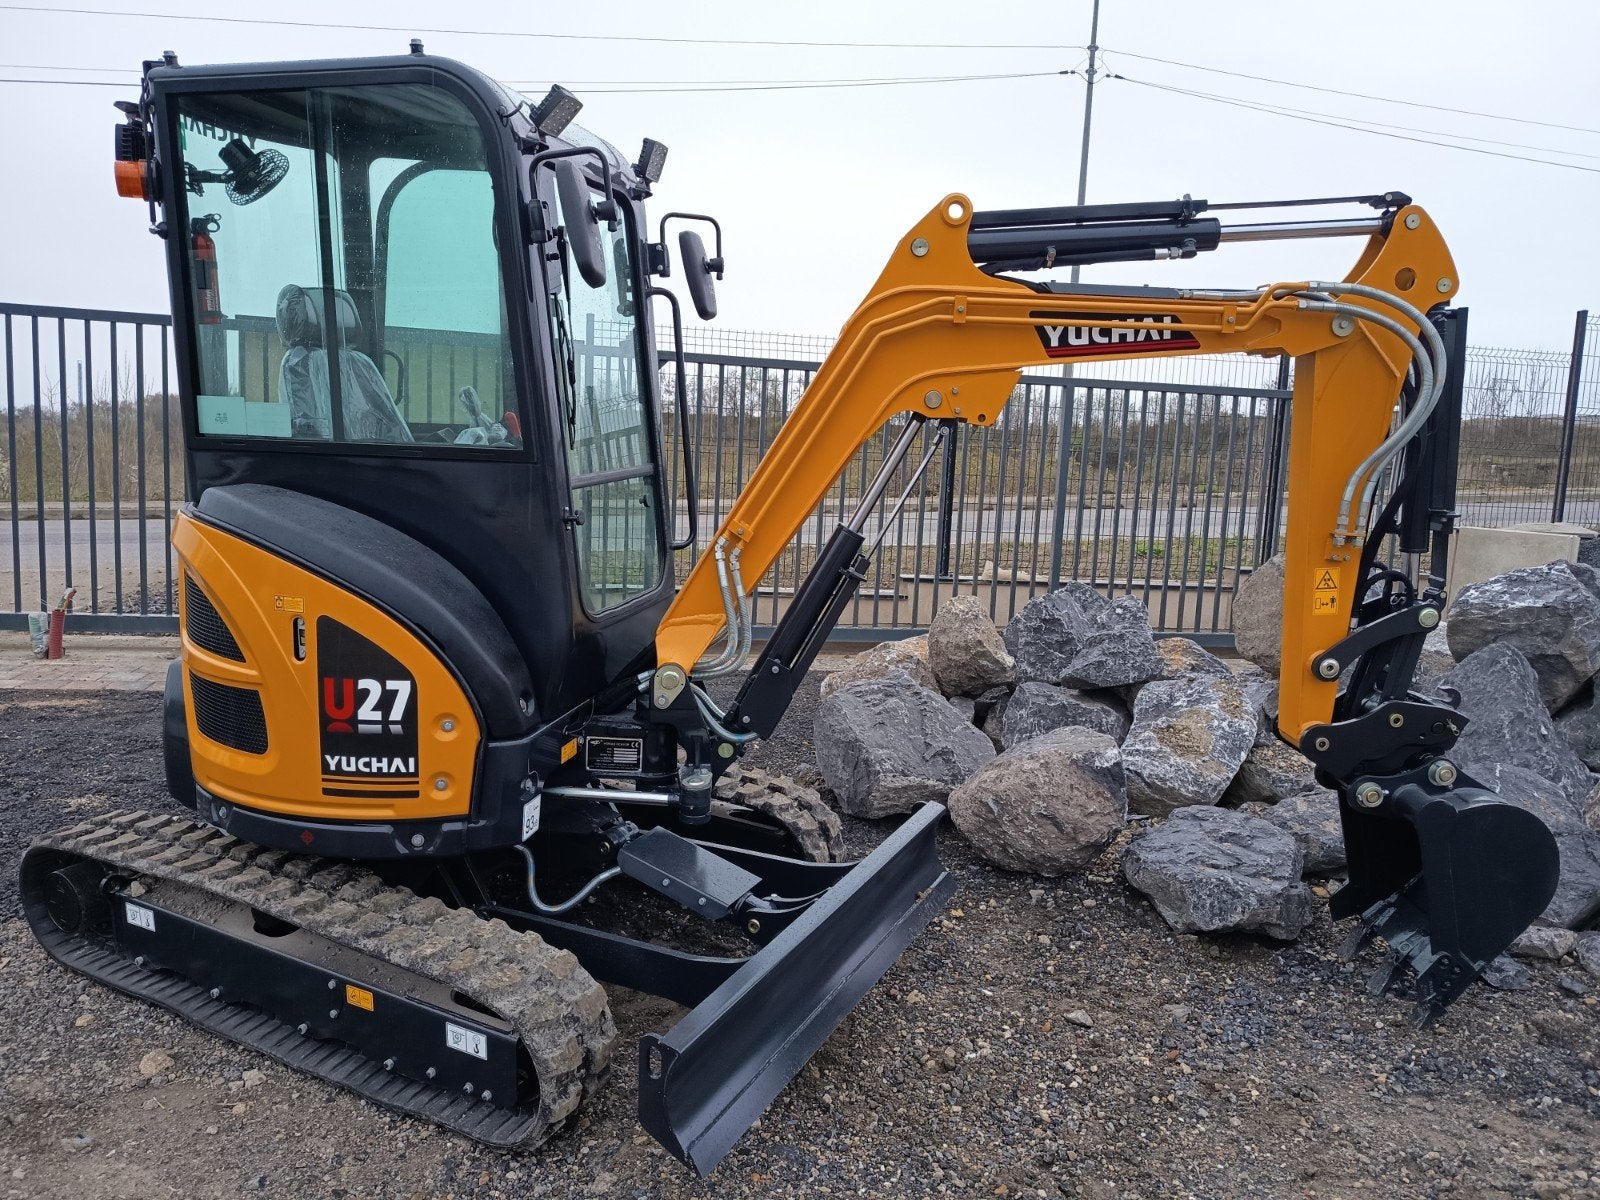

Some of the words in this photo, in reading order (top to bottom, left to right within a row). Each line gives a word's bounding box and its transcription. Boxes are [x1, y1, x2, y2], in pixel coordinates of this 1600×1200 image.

[1044, 316, 1172, 348] YUCHAI
[323, 677, 411, 721] U27
[324, 754, 415, 773] YUCHAI
